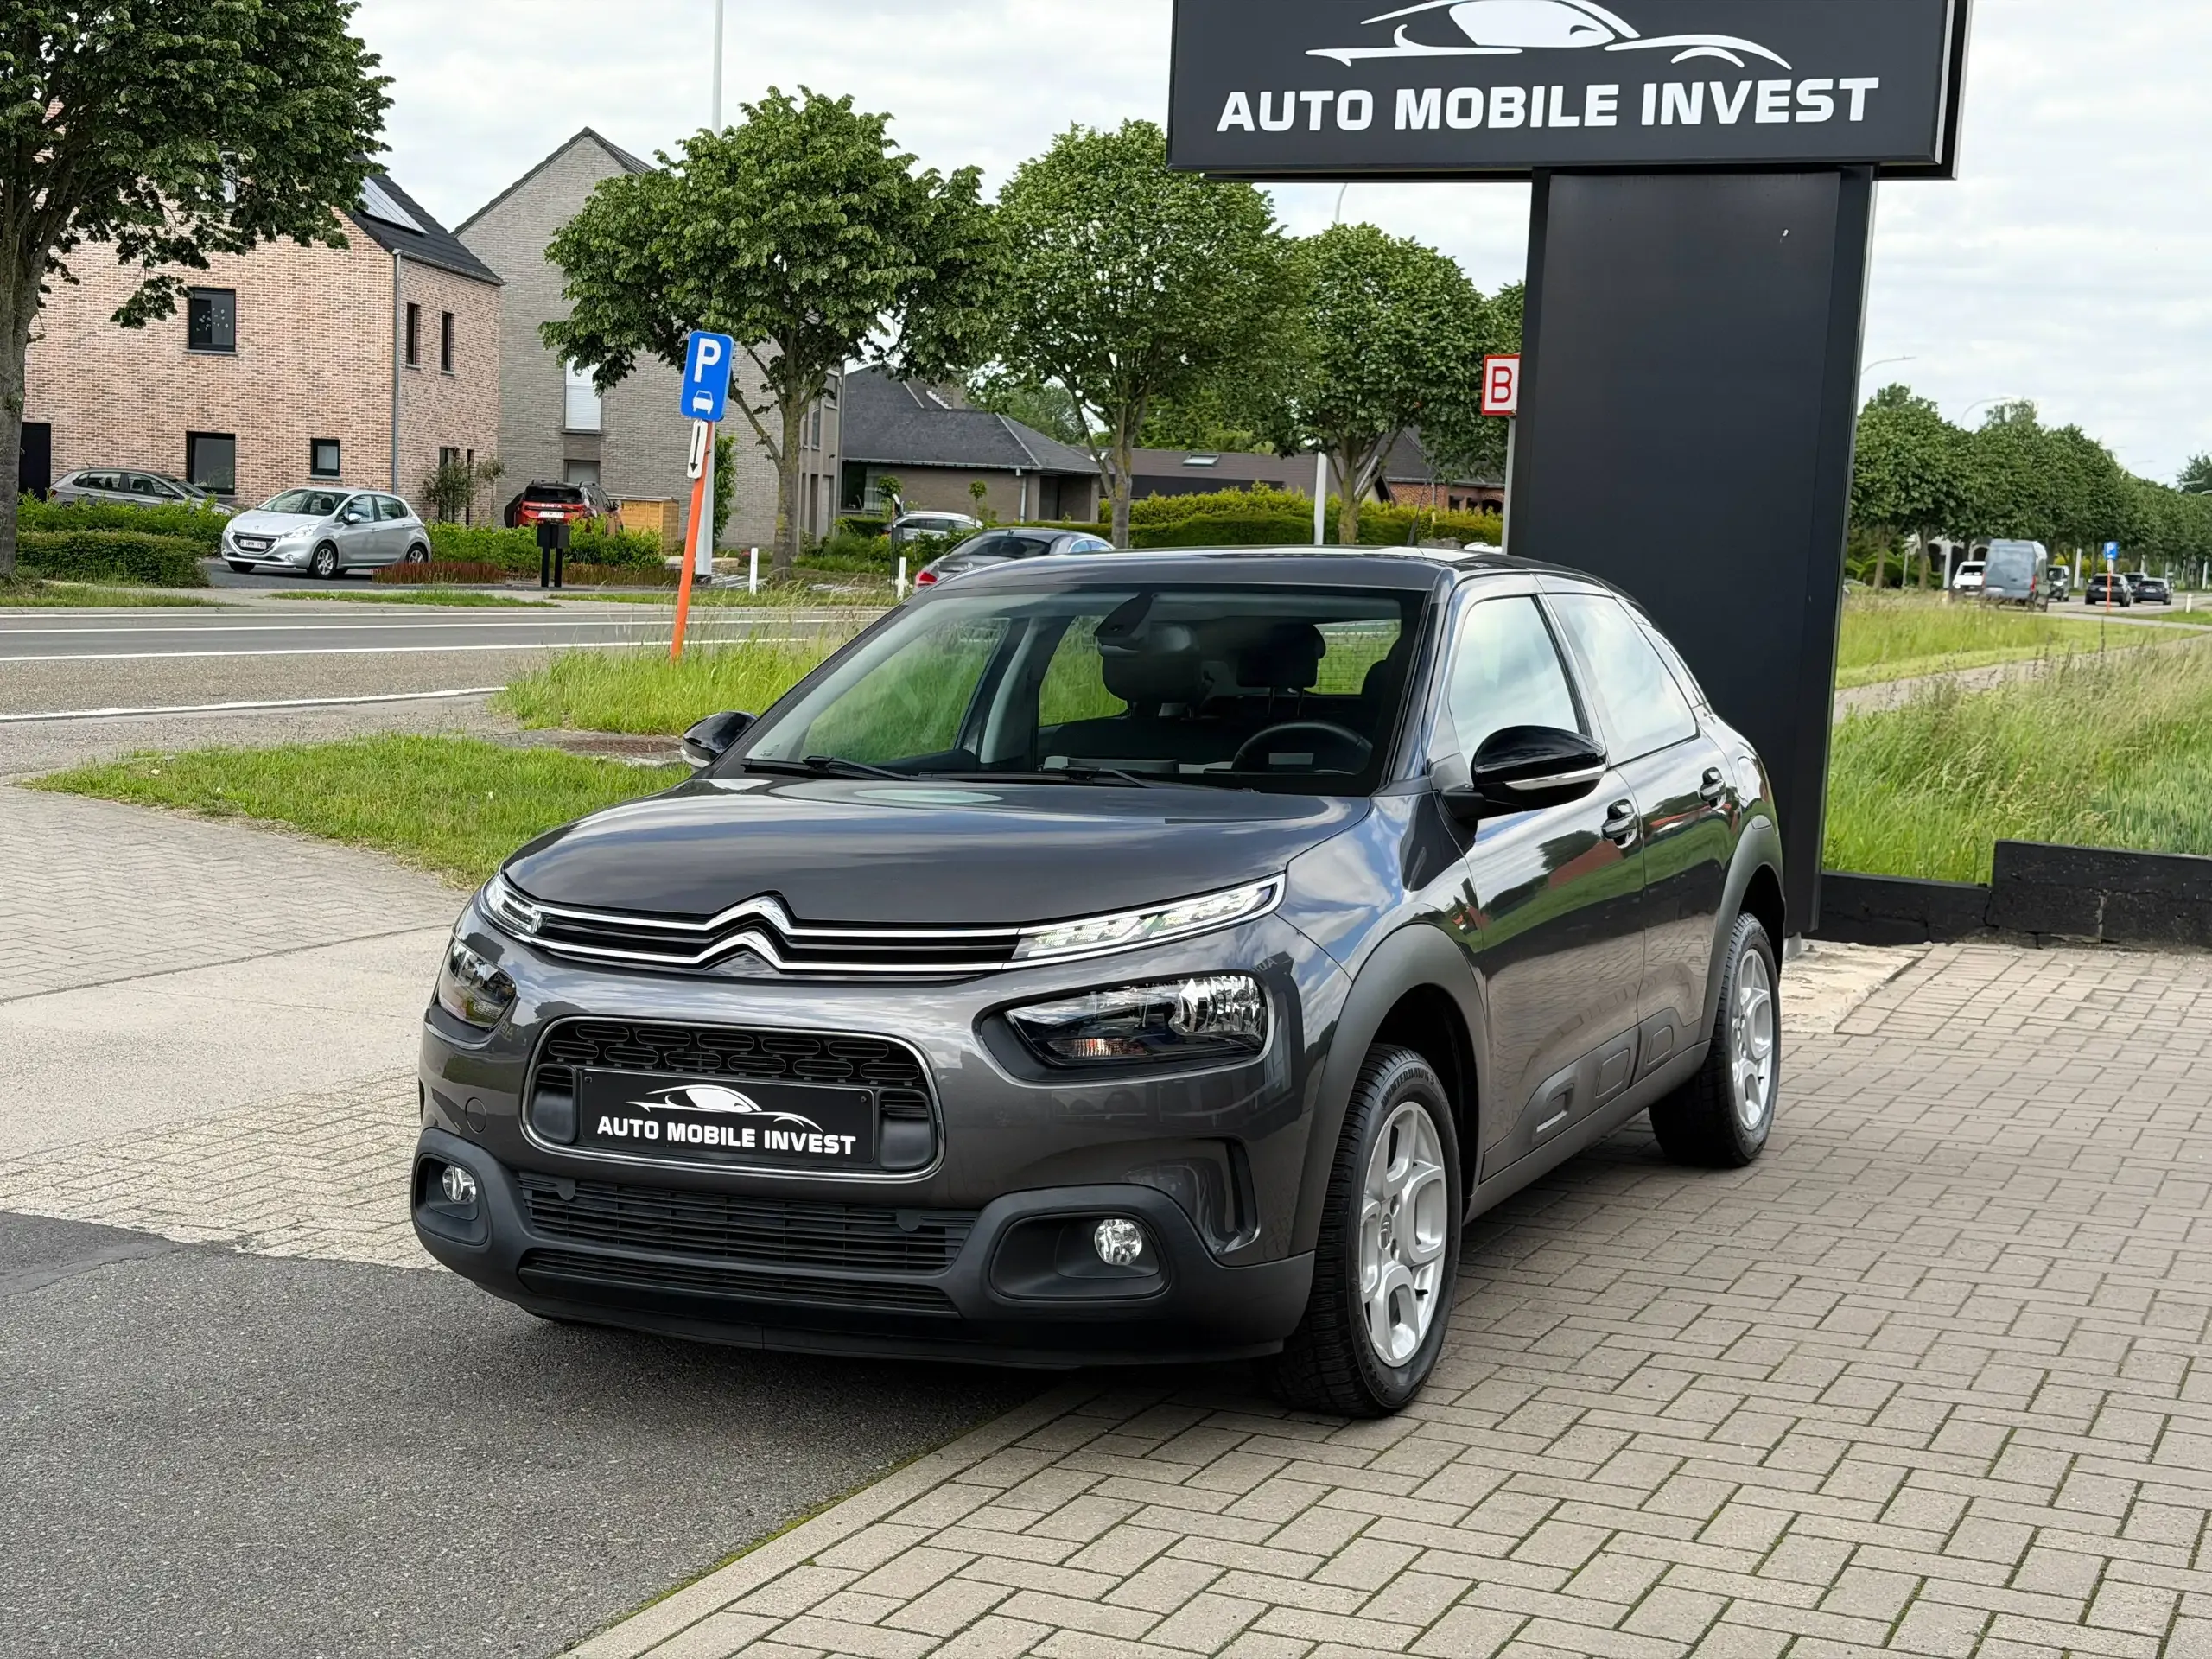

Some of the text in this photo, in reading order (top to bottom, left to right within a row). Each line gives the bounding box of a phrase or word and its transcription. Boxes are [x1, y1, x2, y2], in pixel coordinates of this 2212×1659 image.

[1216, 76, 1879, 132] AUTO MOBILE INVEST
[693, 337, 721, 383] P
[1491, 366, 1513, 404] B
[596, 1116, 856, 1155] AUTO MOBILE INVEST
